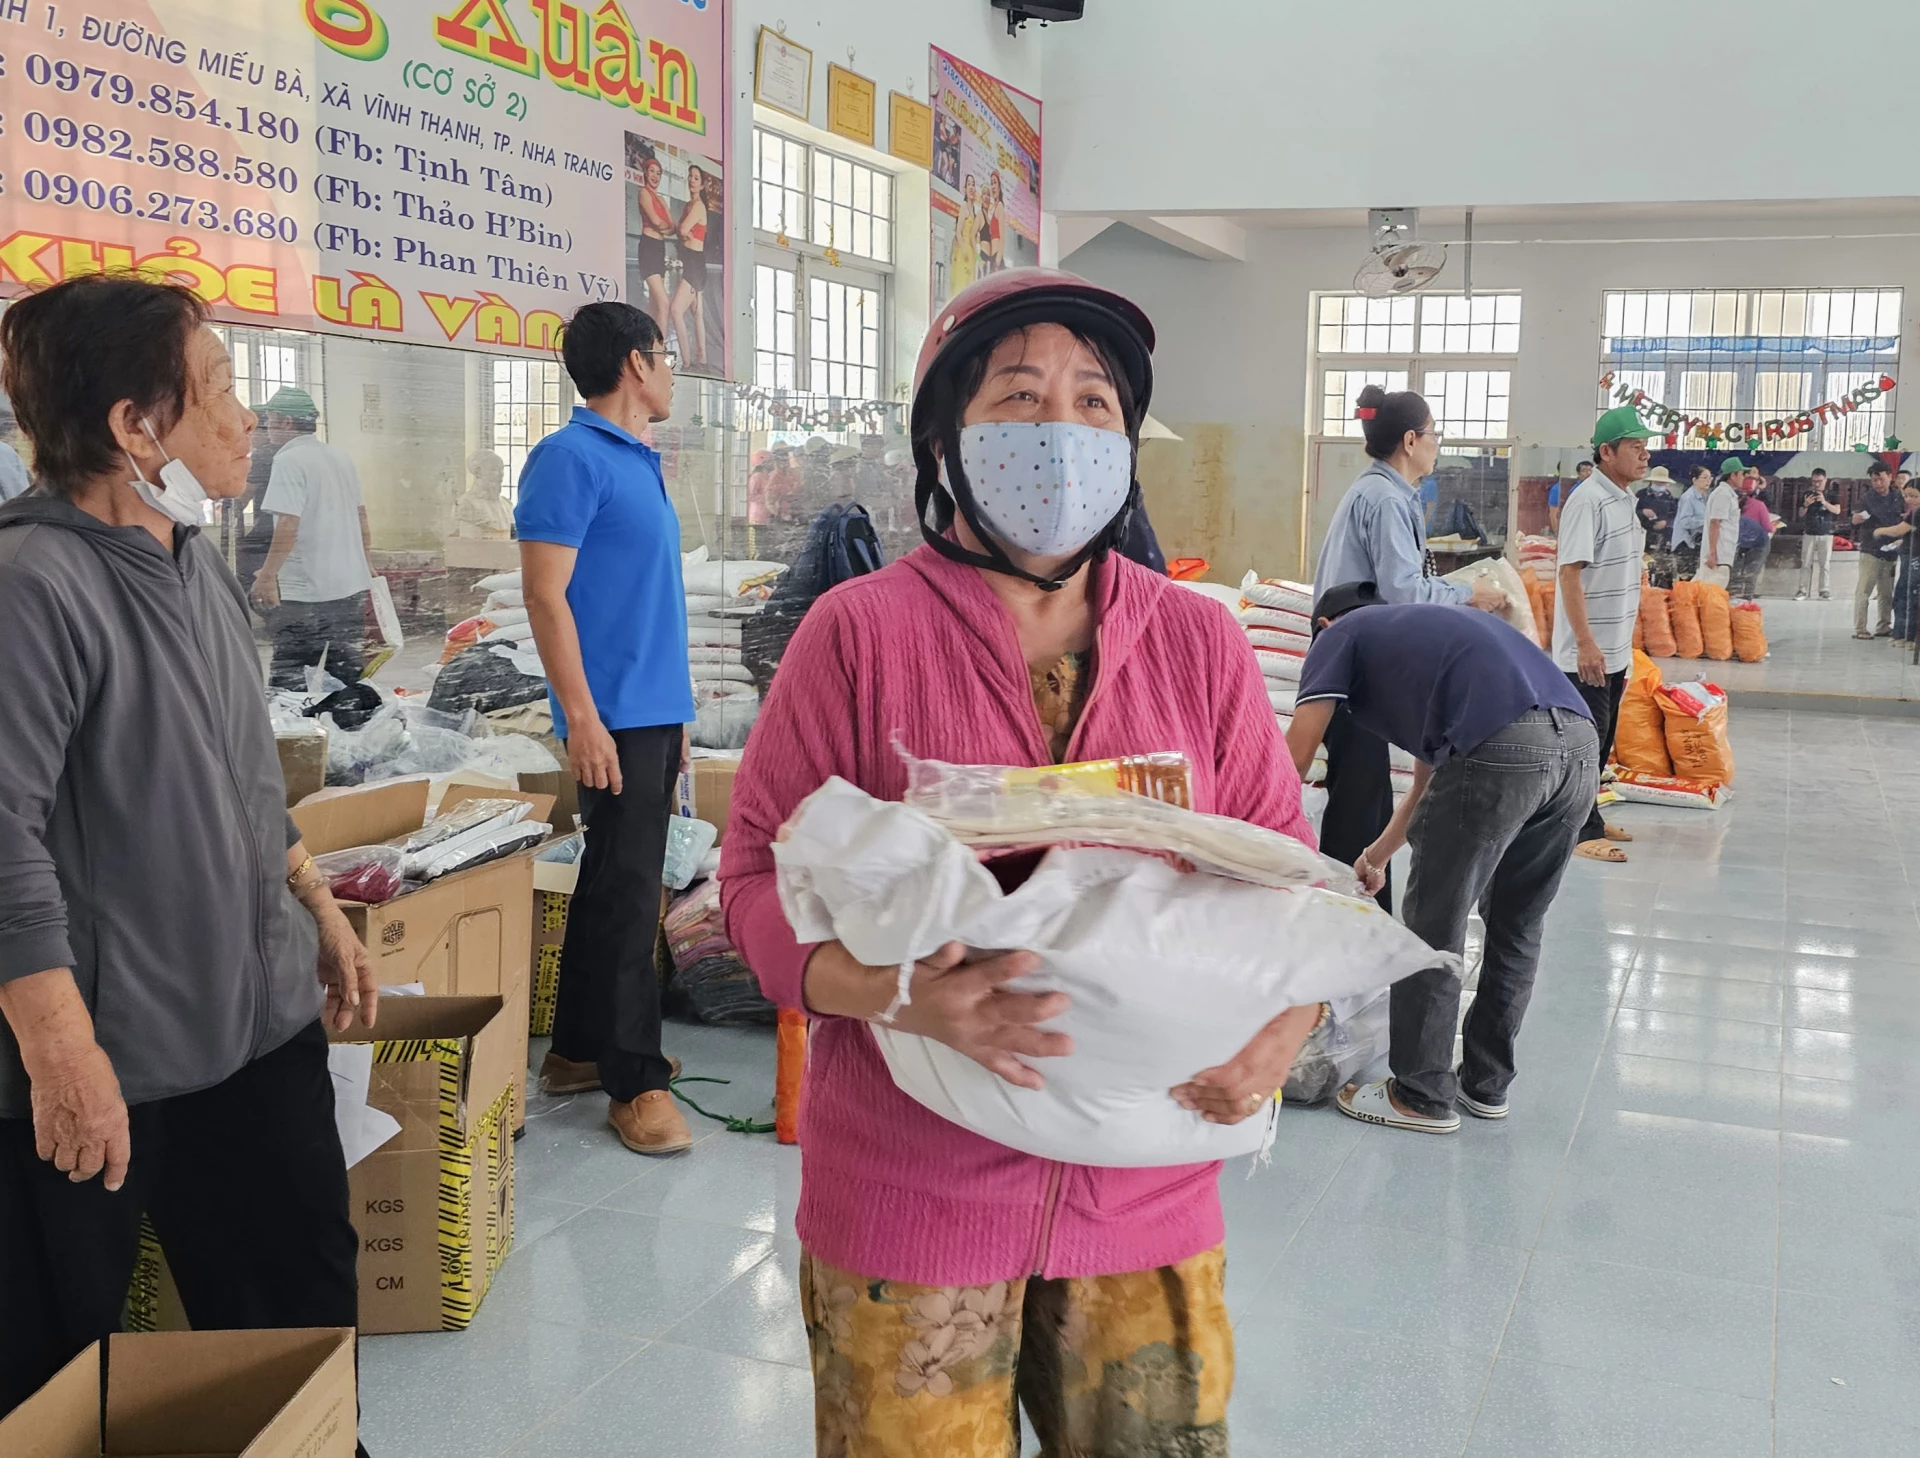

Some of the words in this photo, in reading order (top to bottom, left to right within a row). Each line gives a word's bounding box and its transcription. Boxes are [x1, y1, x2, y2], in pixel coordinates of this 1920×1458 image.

[0, 0, 28, 22] H
[47, 5, 64, 37] 1,
[82, 16, 187, 64] ĐƯỜNG
[199, 48, 265, 85] MIẾU
[274, 69, 310, 103] BÀ,
[321, 82, 352, 111] XÃ
[364, 92, 411, 126] VĨNH
[420, 110, 484, 150] THẠNH,
[493, 131, 514, 155] TP.
[522, 141, 556, 167] NHA
[564, 153, 614, 182] TRANG
[403, 59, 454, 96] (CƠ
[463, 73, 497, 109] SỞ
[505, 91, 528, 122] 2)
[25, 54, 299, 145] 0979.854.180
[314, 125, 383, 165] (Fb:
[395, 144, 470, 186] Tịnh
[480, 166, 553, 208] Tâm)
[24, 112, 297, 194] 0982.588.580
[313, 173, 382, 212] (Fb:
[393, 190, 475, 231] Thảo
[24, 169, 297, 243] 0906.273.680
[313, 222, 382, 260] (Fb:
[393, 236, 477, 275] Phan
[487, 255, 570, 293] Thiên
[577, 272, 619, 303] Vỹ)
[312, 269, 403, 333] LÀ
[418, 290, 563, 351] VÀN
[1725, 380, 1882, 444] CHRISTMAS
[1357, 1111, 1386, 1123] crocs
[366, 1199, 404, 1214] KGS
[364, 1238, 404, 1252] KGS
[376, 1276, 404, 1290] CM
